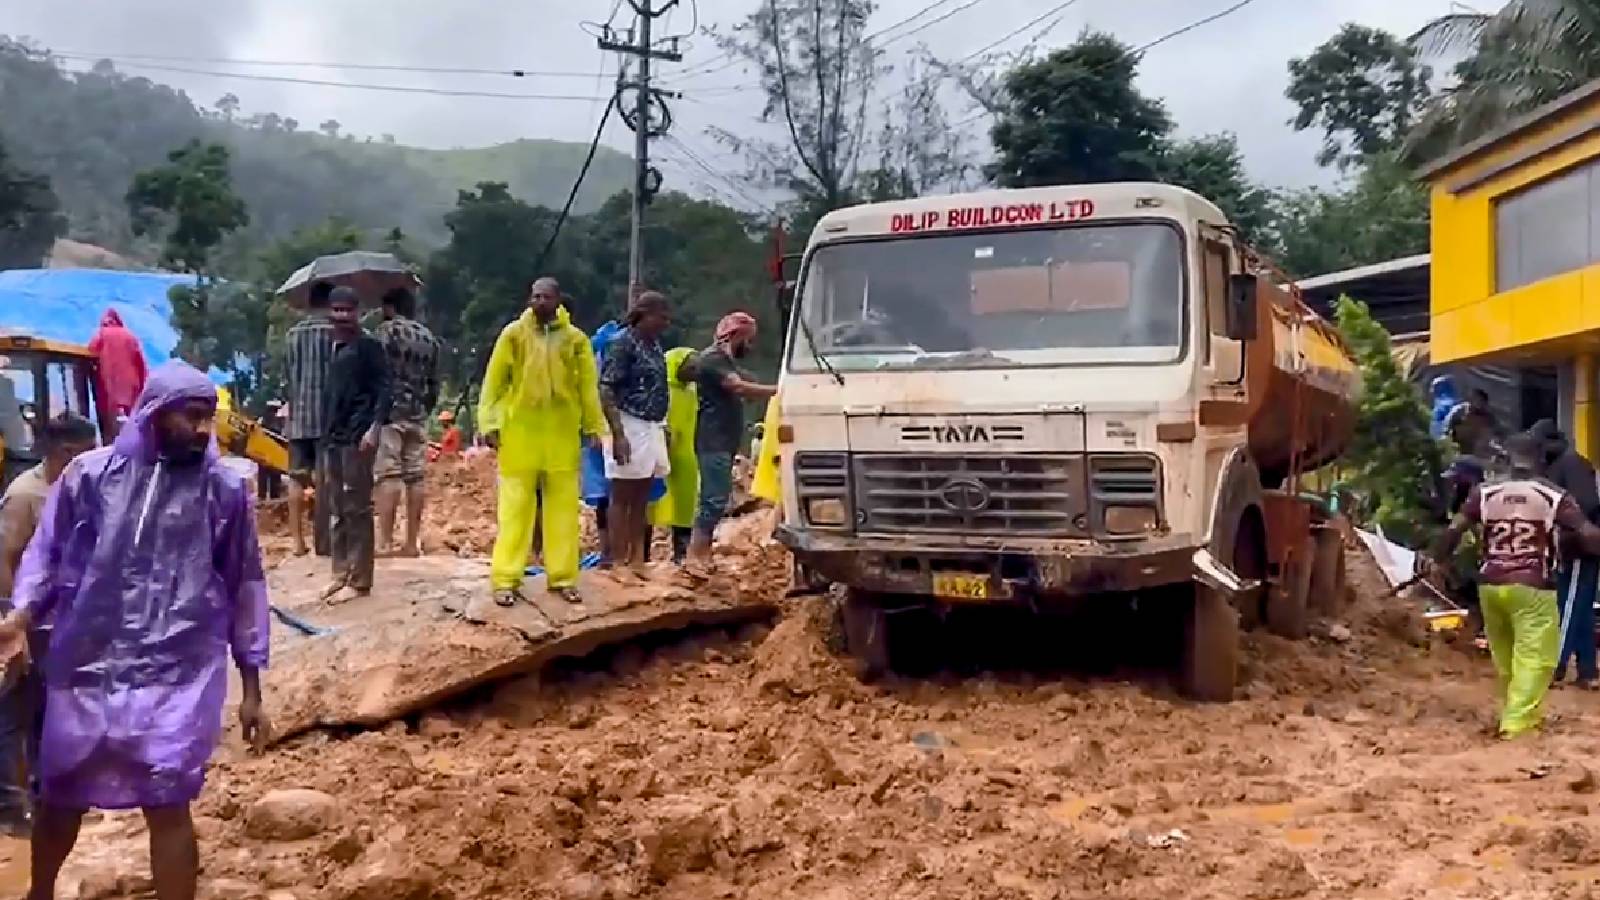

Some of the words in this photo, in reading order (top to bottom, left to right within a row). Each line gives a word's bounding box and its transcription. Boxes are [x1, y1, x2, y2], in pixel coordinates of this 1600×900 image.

[890, 211, 940, 232] DILIP
[948, 203, 1043, 228] BUILDCON
[1050, 199, 1095, 220] LTD
[933, 425, 989, 443] TATA
[1488, 521, 1537, 555] 22
